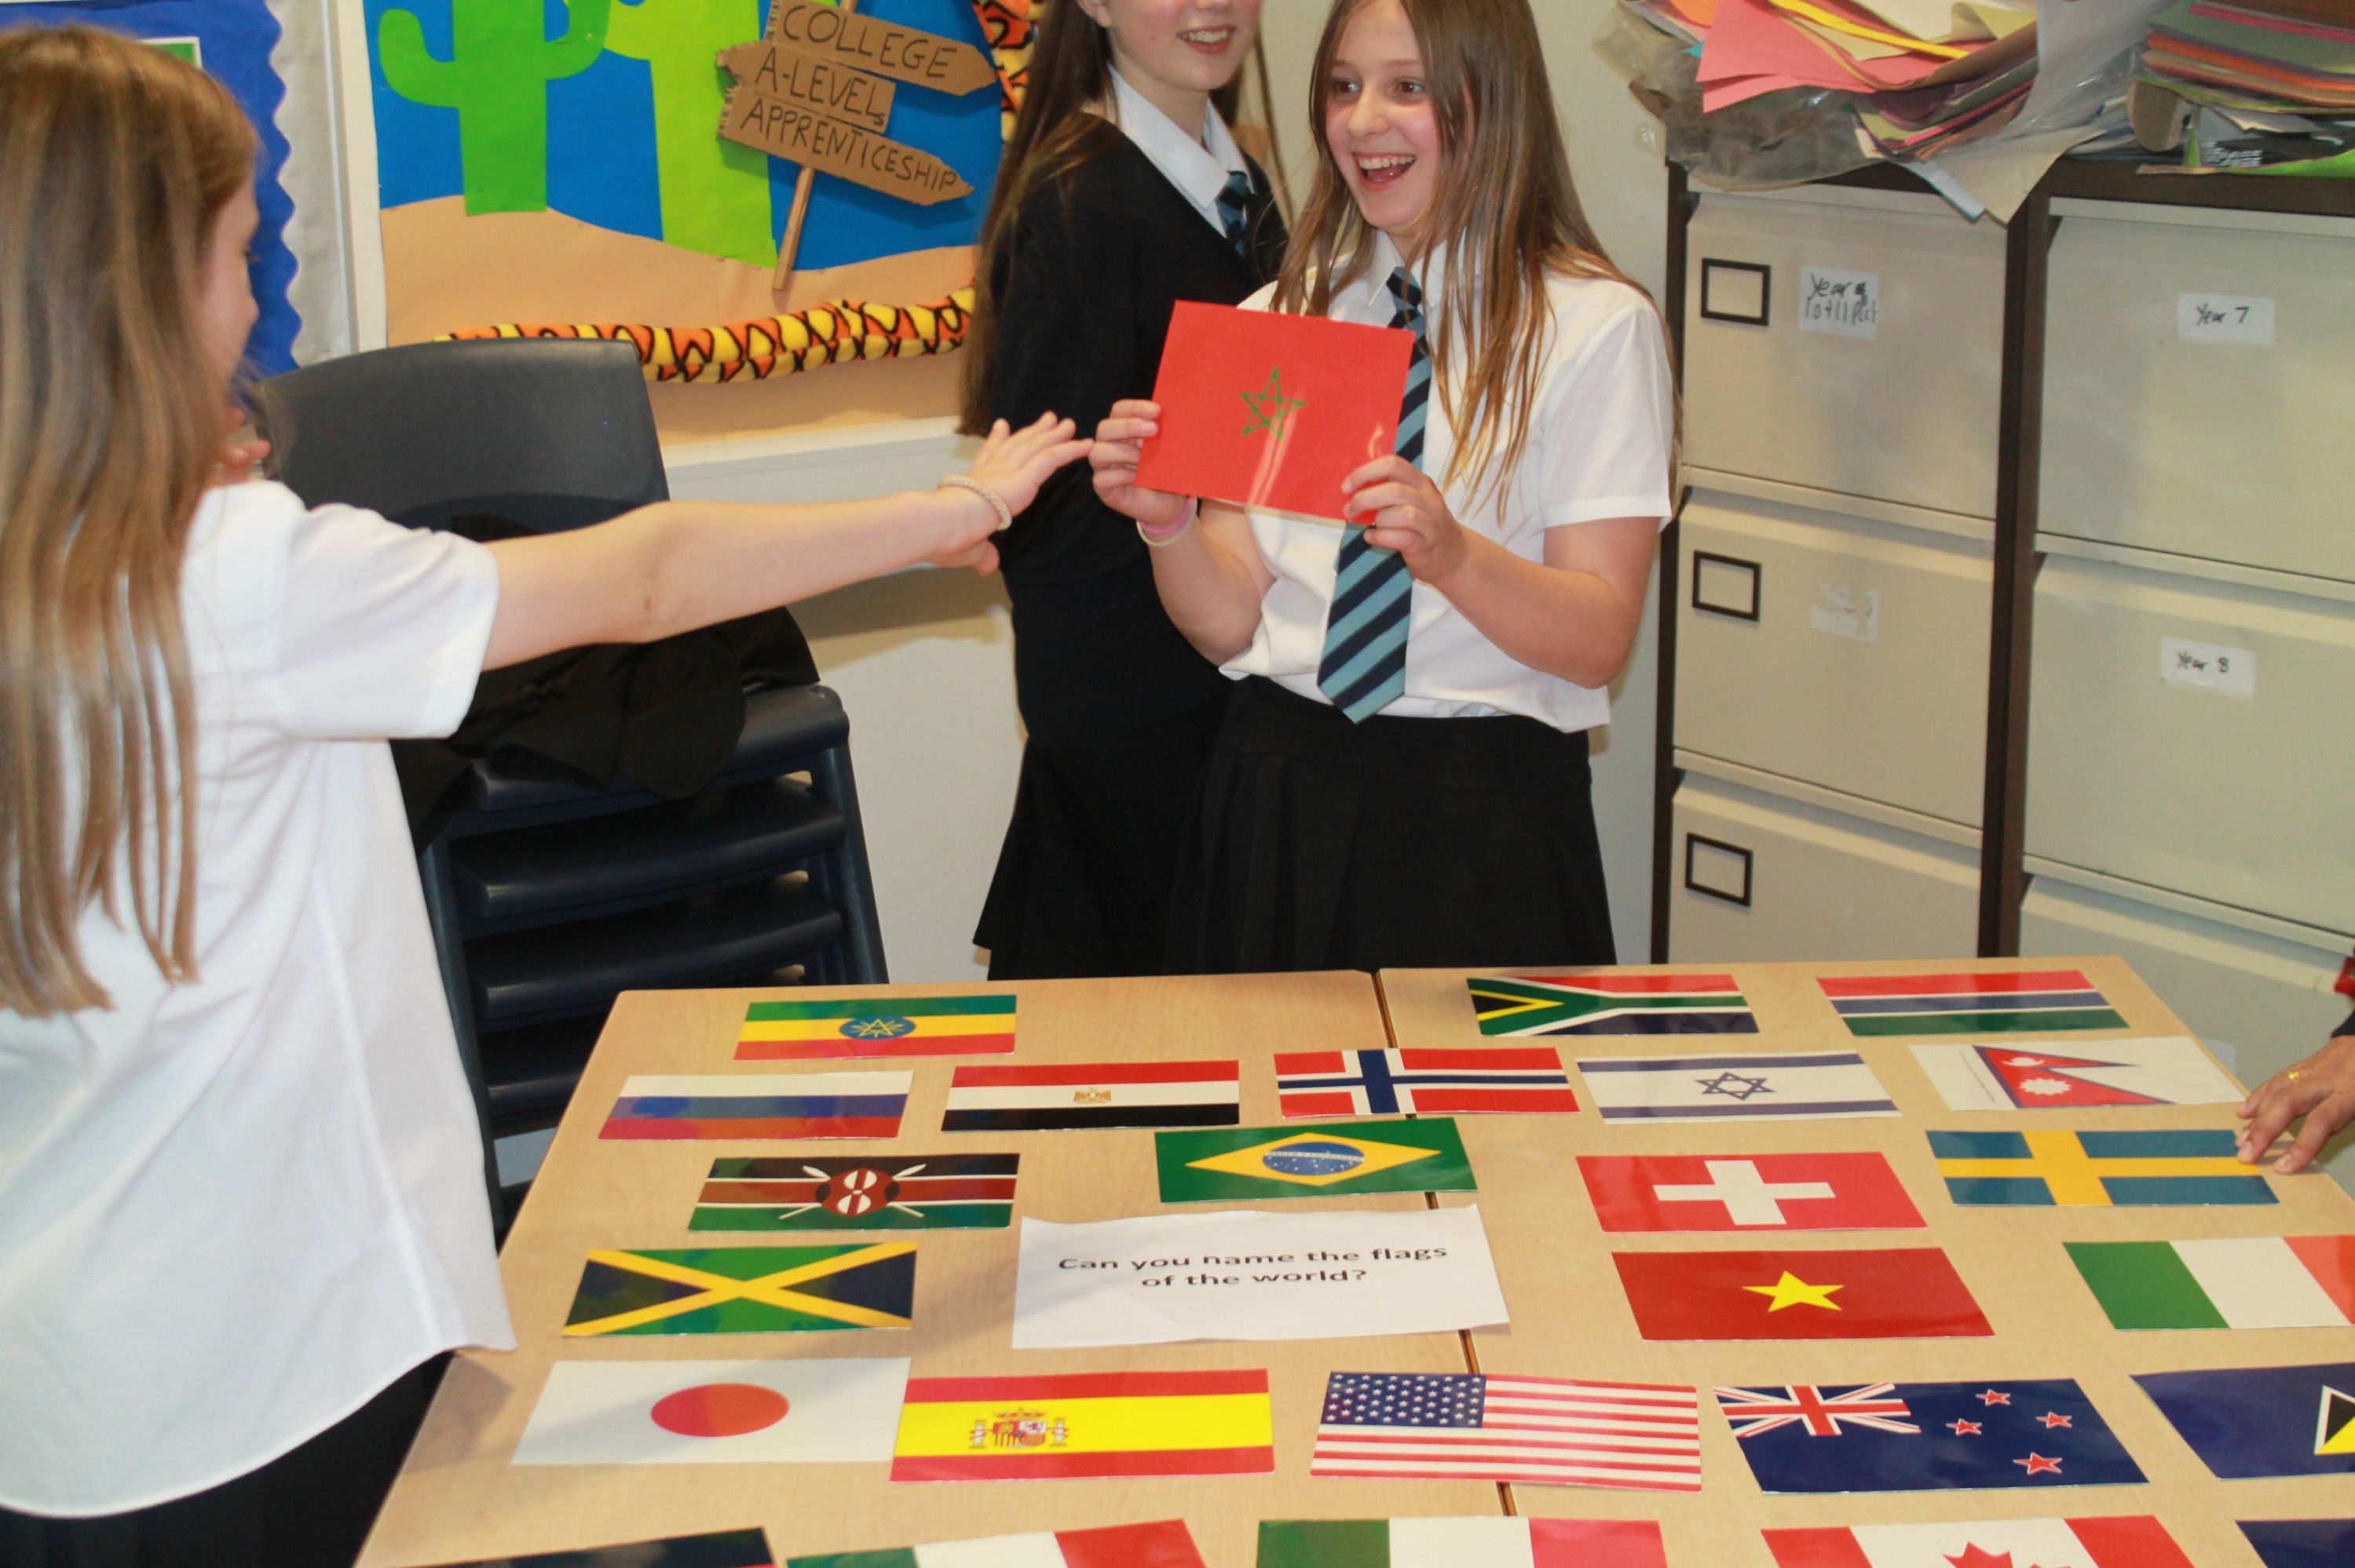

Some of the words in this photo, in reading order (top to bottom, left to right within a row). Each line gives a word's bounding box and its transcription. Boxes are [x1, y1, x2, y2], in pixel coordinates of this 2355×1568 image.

[783, 5, 957, 78] COLLEGE
[740, 98, 958, 192] APPRENTICESHIP
[1806, 272, 1852, 301] Year
[2196, 302, 2227, 326] Year
[2235, 305, 2250, 323] 7
[2177, 651, 2208, 671] Year
[2217, 657, 2229, 673] 8
[1059, 1258, 1118, 1269] Can
[1131, 1256, 1190, 1270] you
[1203, 1255, 1294, 1265] name
[1306, 1251, 1360, 1261] the
[1370, 1248, 1448, 1260] flags
[1141, 1274, 1176, 1286] of
[1186, 1274, 1240, 1285] the
[1252, 1269, 1367, 1282] world?
